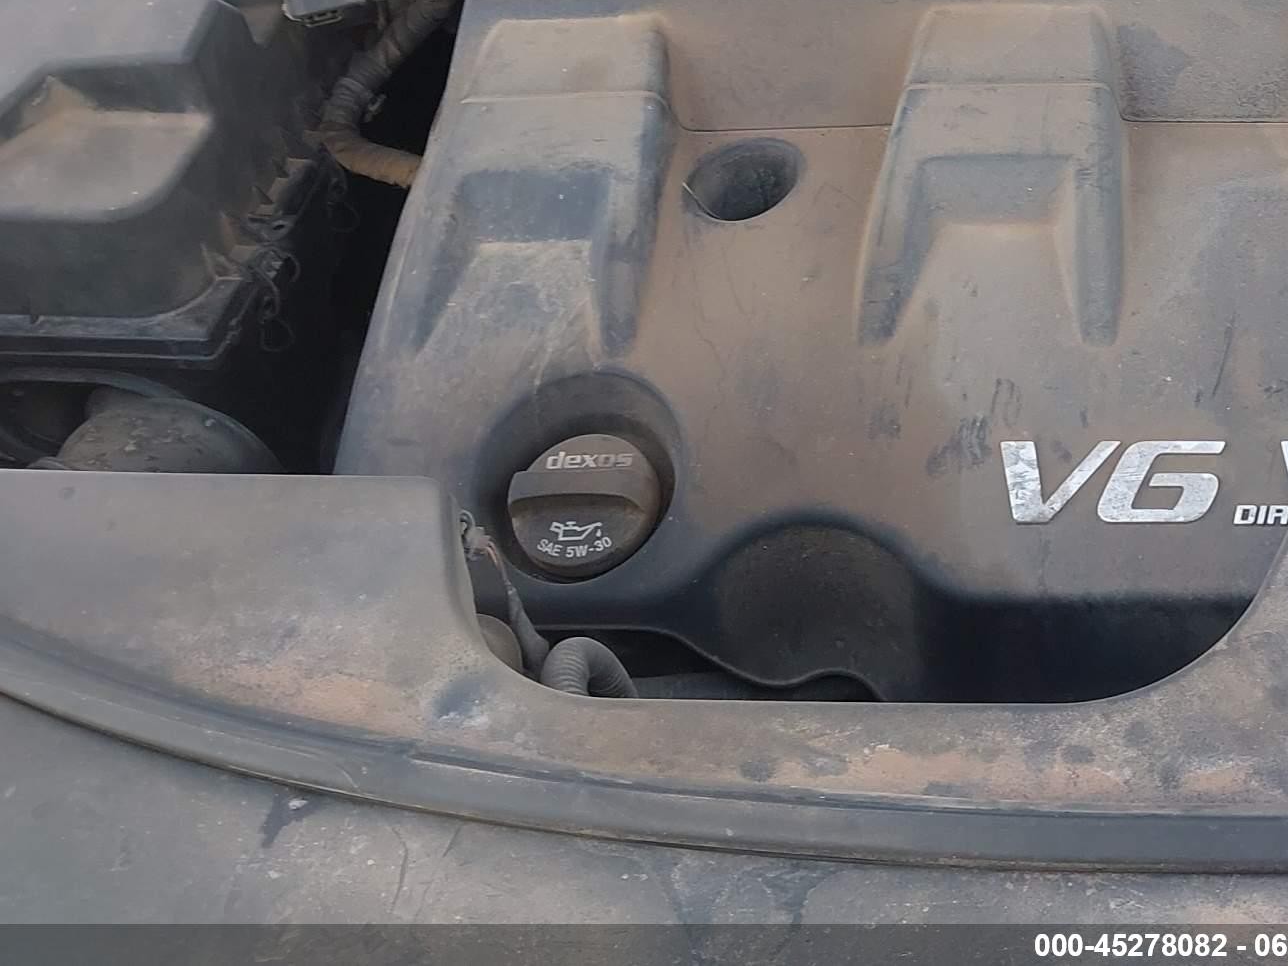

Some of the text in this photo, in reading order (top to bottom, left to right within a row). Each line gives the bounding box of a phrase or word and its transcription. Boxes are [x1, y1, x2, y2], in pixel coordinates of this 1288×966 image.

[545, 451, 634, 470] dexos
[999, 440, 1226, 519] V6
[536, 537, 613, 558] SAE 5W-30
